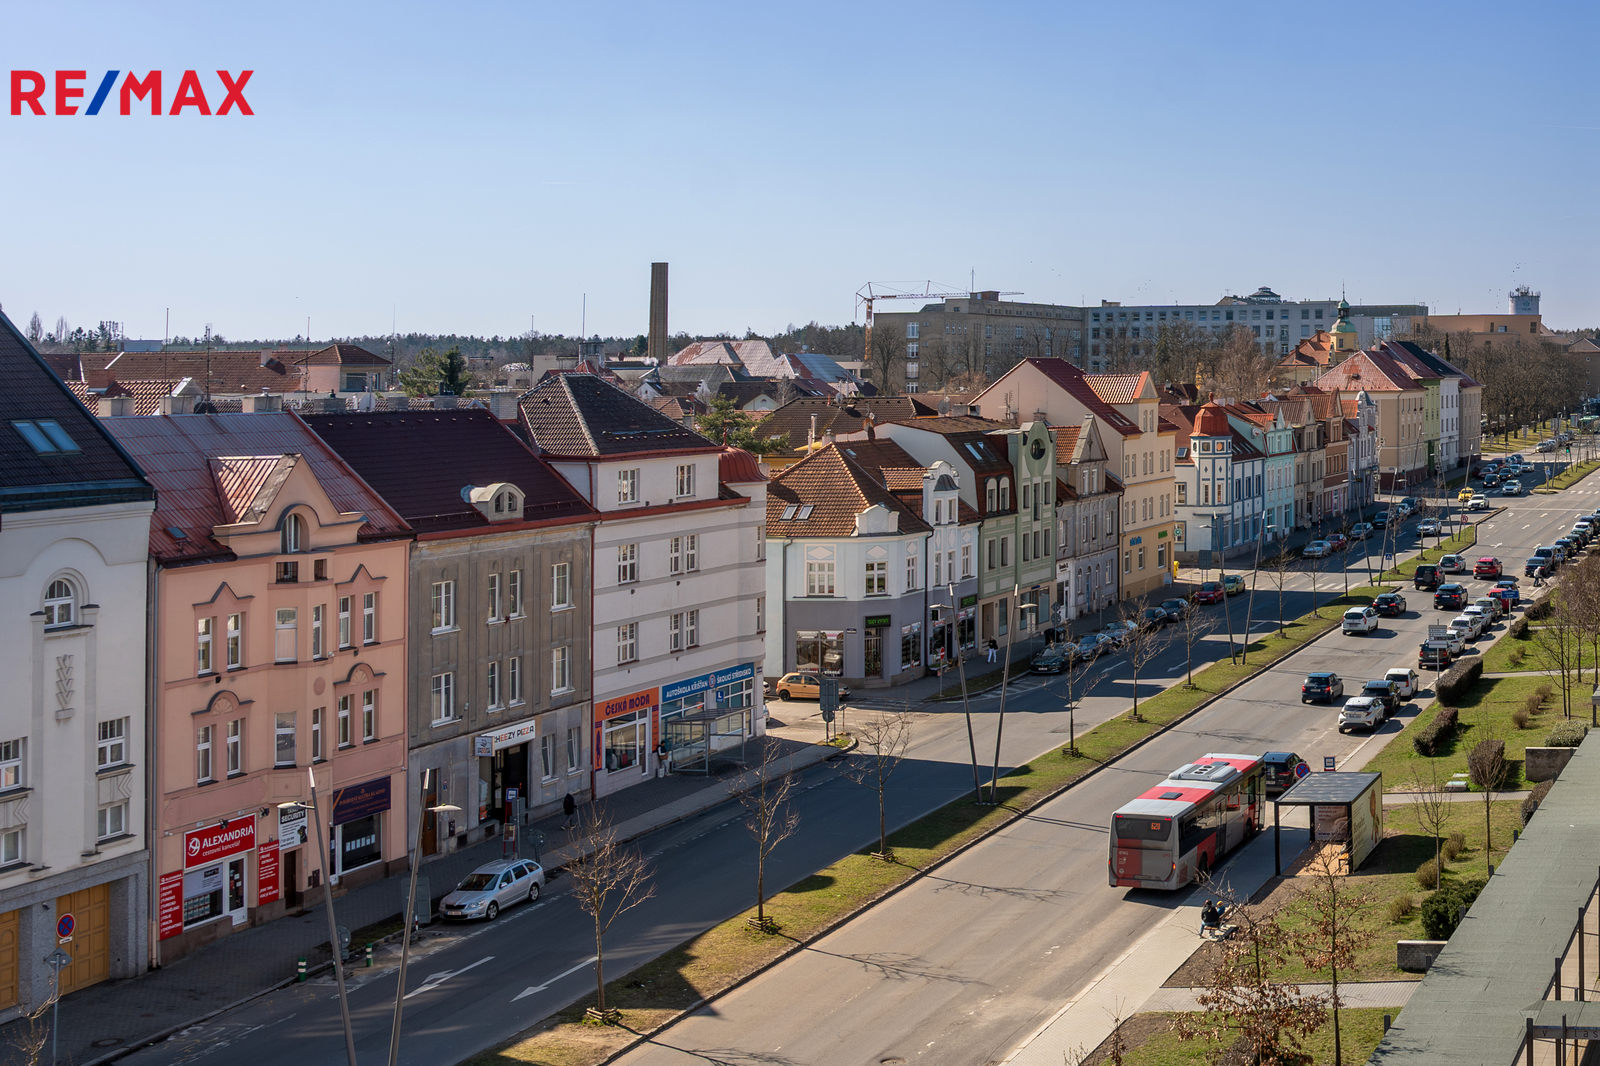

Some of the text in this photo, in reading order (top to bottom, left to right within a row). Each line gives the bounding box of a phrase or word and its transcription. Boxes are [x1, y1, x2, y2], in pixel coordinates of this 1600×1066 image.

[732, 668, 751, 680] STŘEDISKO
[666, 685, 691, 698] AUTOŠKOLA
[605, 698, 627, 716] ČESKÁ
[629, 694, 650, 709] MÓDA
[516, 725, 534, 737] PIZZA
[281, 811, 305, 823] SECURITY
[202, 825, 254, 849] ALEXANDRIA
[202, 840, 241, 857] cestovní kancelář
